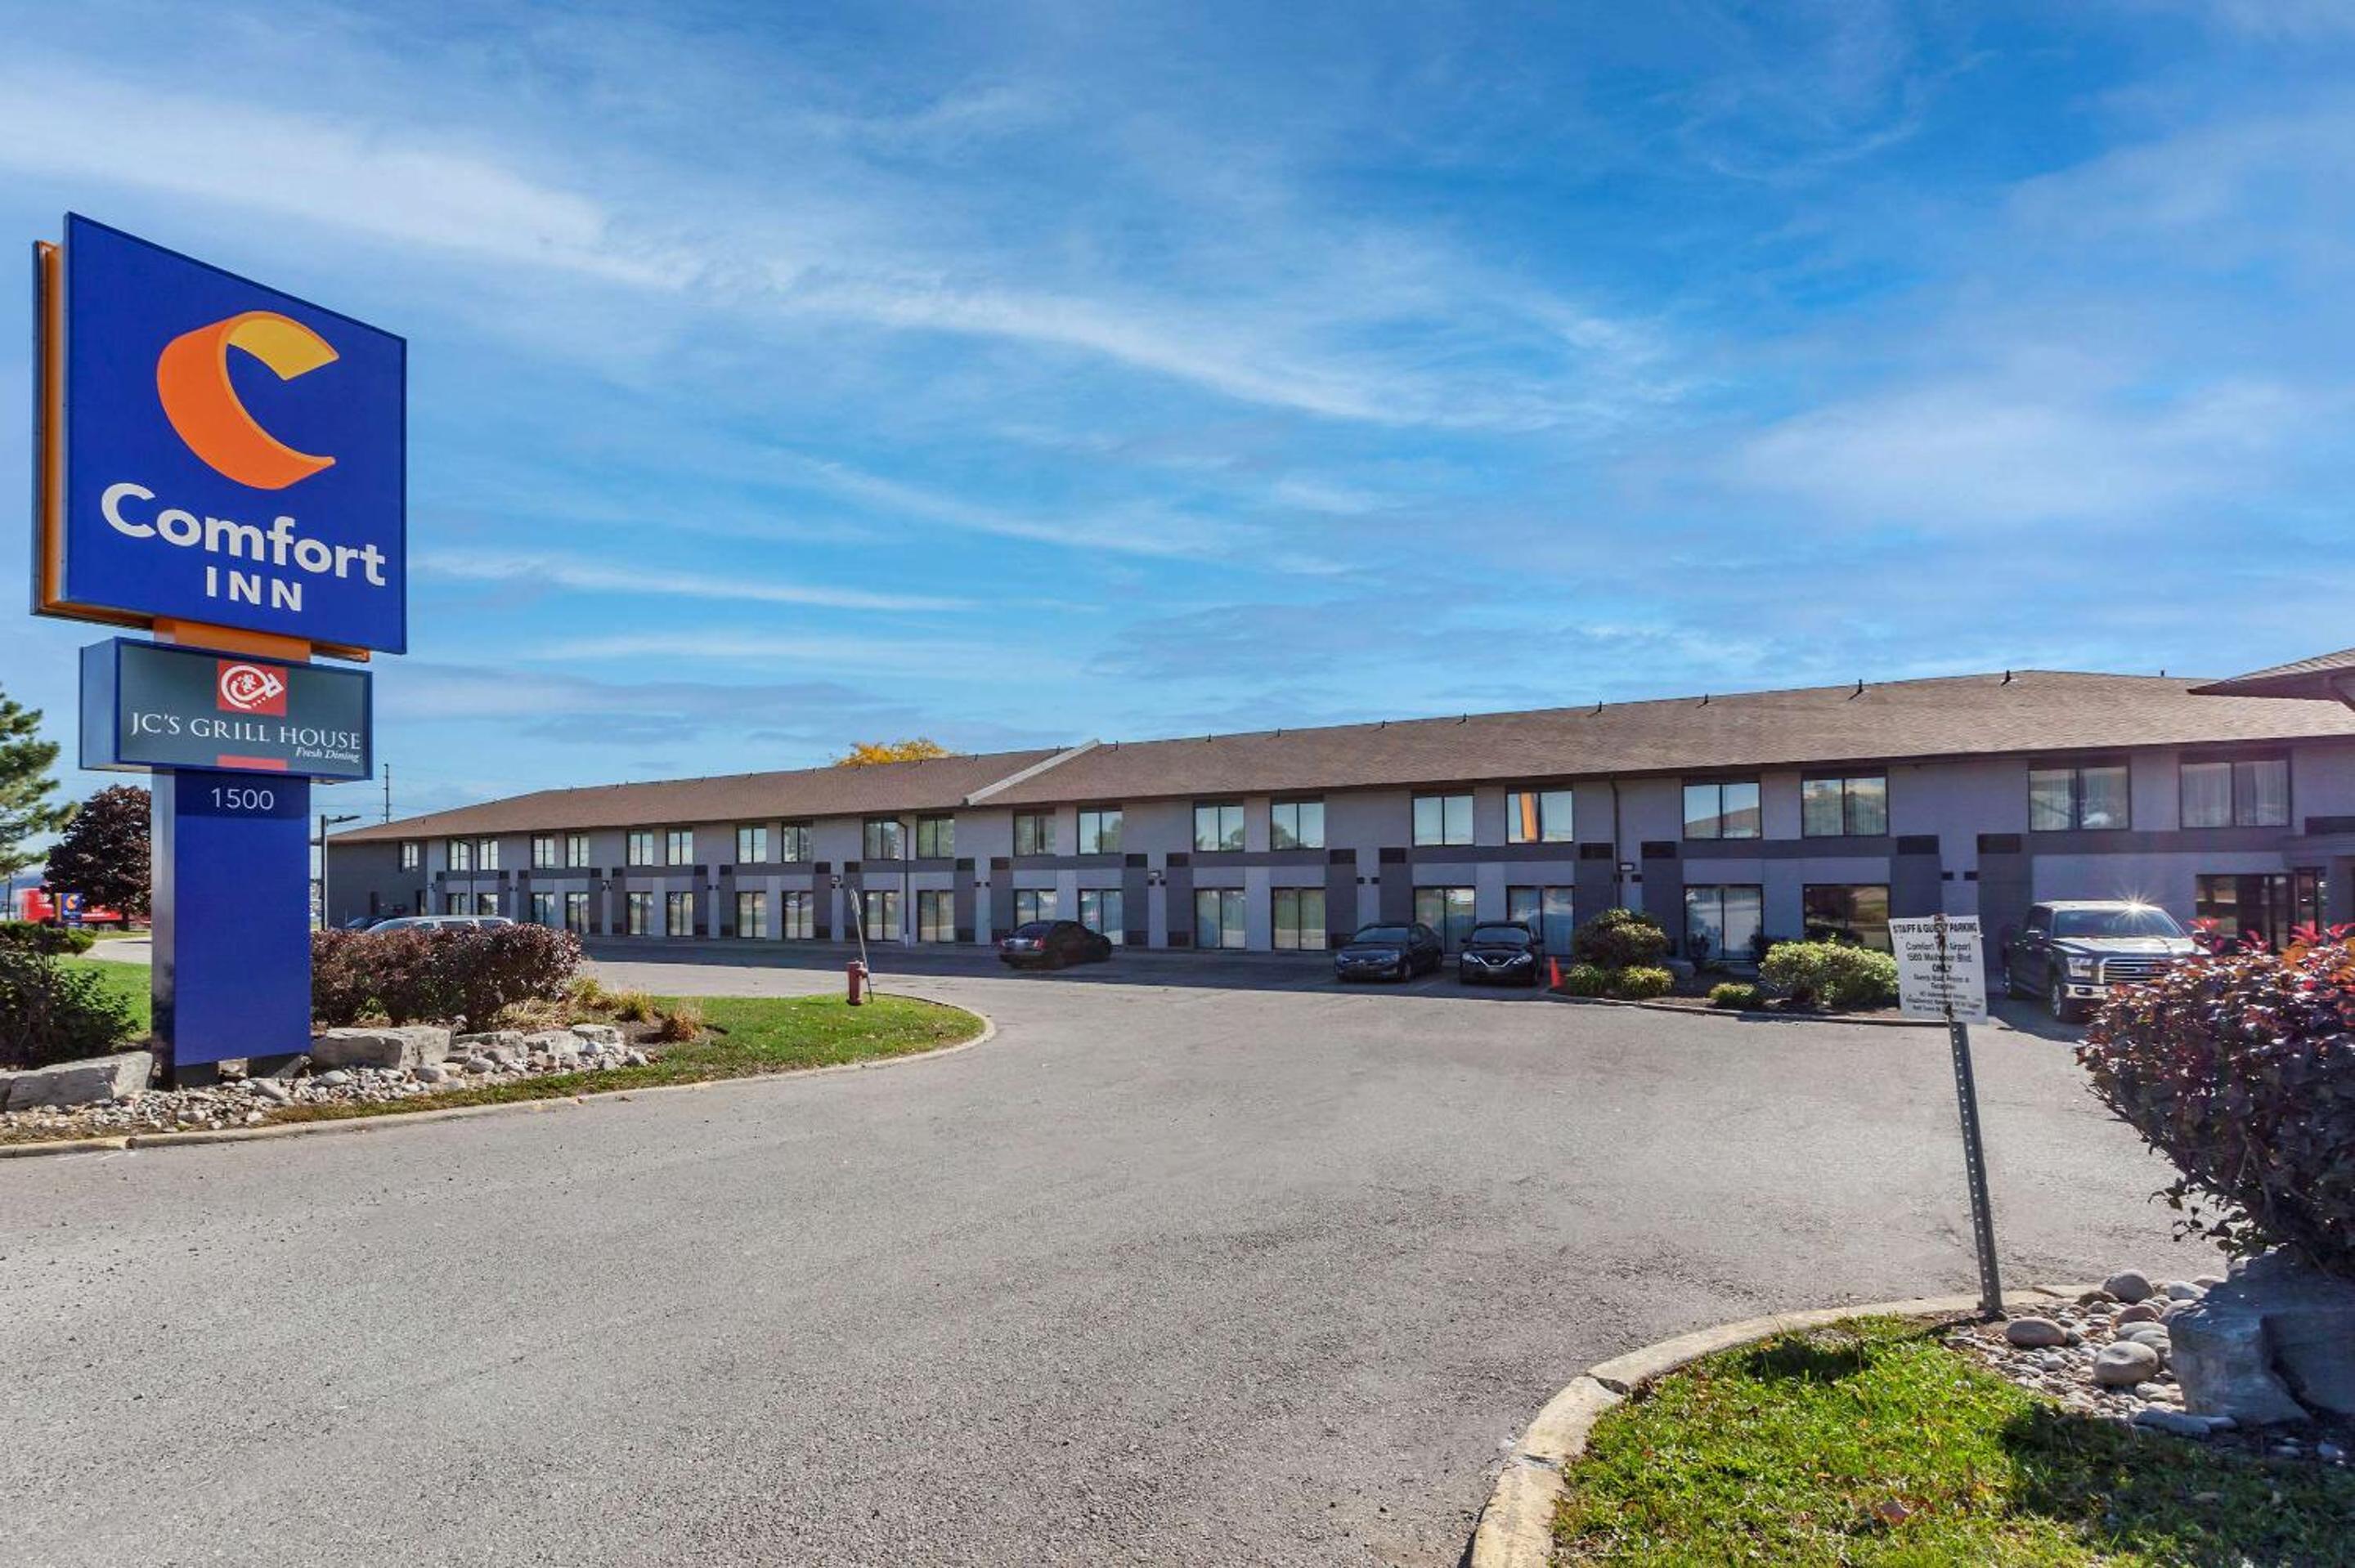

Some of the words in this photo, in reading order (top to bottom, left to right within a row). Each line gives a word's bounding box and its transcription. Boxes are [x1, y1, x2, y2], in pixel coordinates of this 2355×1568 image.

[101, 482, 385, 586] Comfort
[206, 566, 302, 612] INN
[131, 712, 181, 735] JC'S
[190, 718, 271, 742] GRILL
[280, 726, 361, 750] HOUSE
[296, 746, 323, 759] Fresh
[325, 749, 360, 763] Dining
[211, 787, 274, 810] 1500
